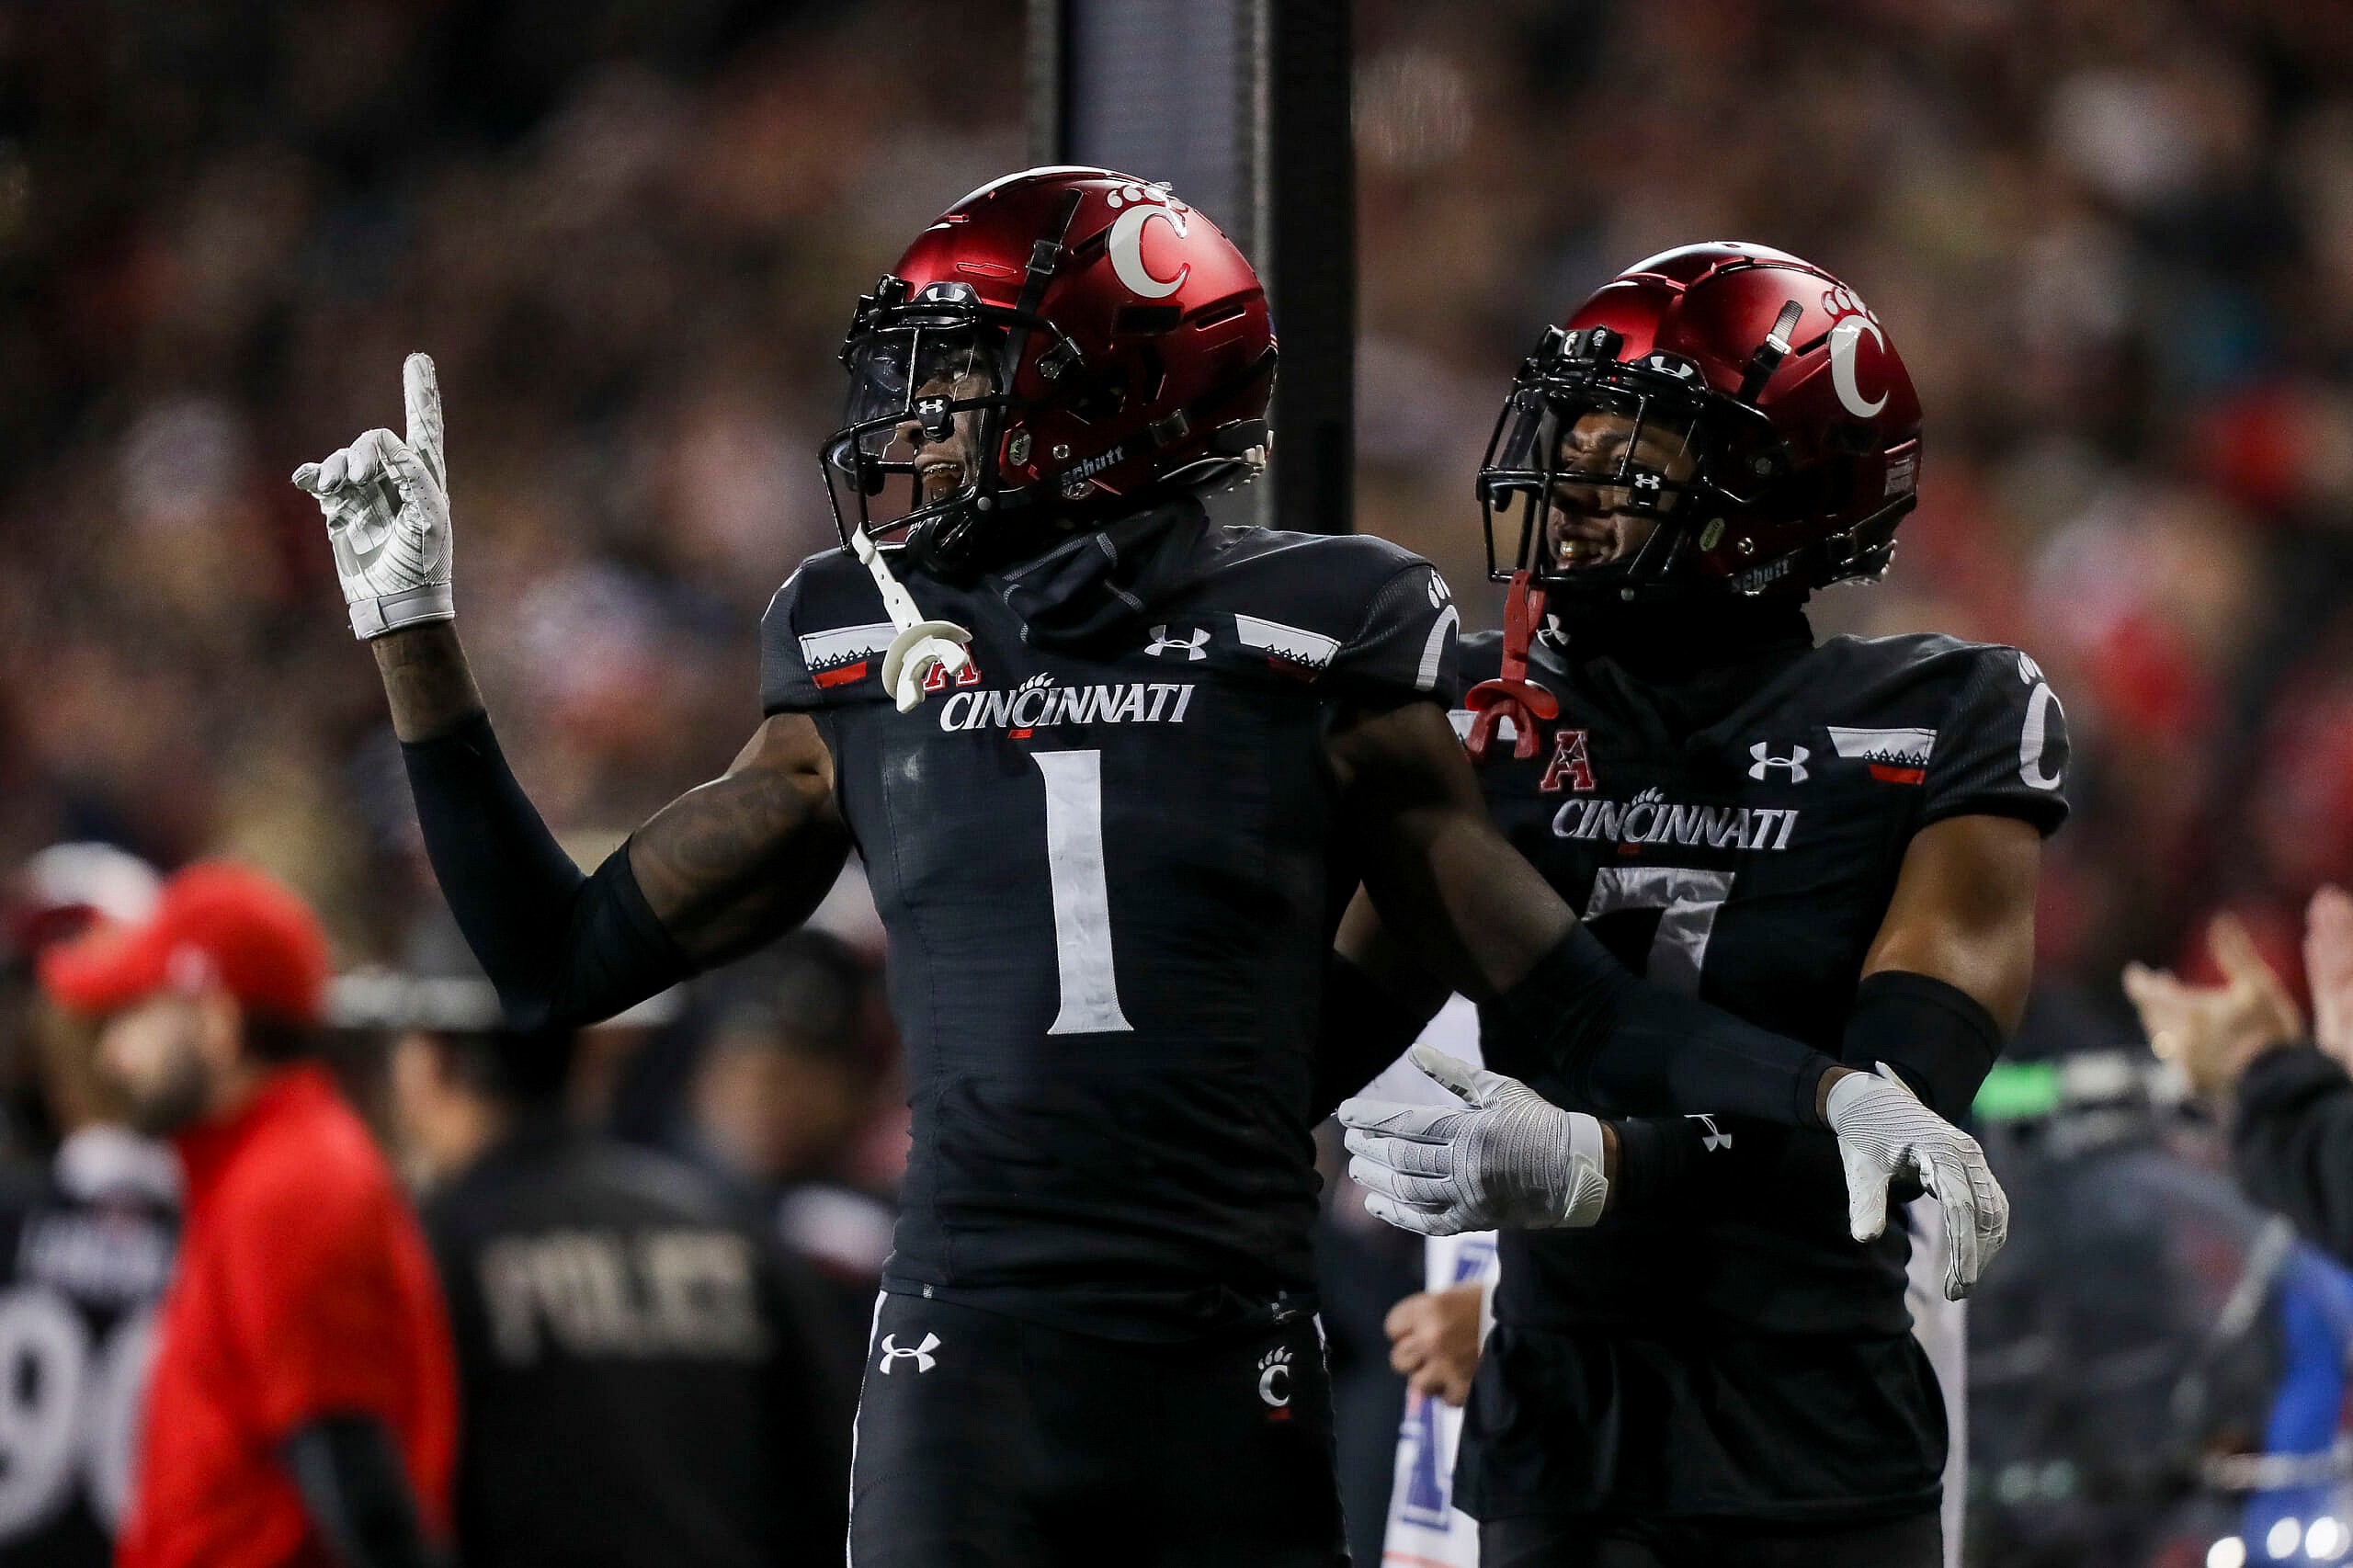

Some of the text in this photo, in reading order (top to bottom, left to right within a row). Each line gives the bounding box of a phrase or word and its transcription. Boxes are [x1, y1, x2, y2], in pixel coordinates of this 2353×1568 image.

[939, 678, 1195, 733] CINCINNATI
[1552, 792, 1800, 850] CINCINNATI
[1030, 749, 1134, 1036] 1
[1581, 867, 1735, 1006] 7
[481, 1227, 770, 1369] POLICE
